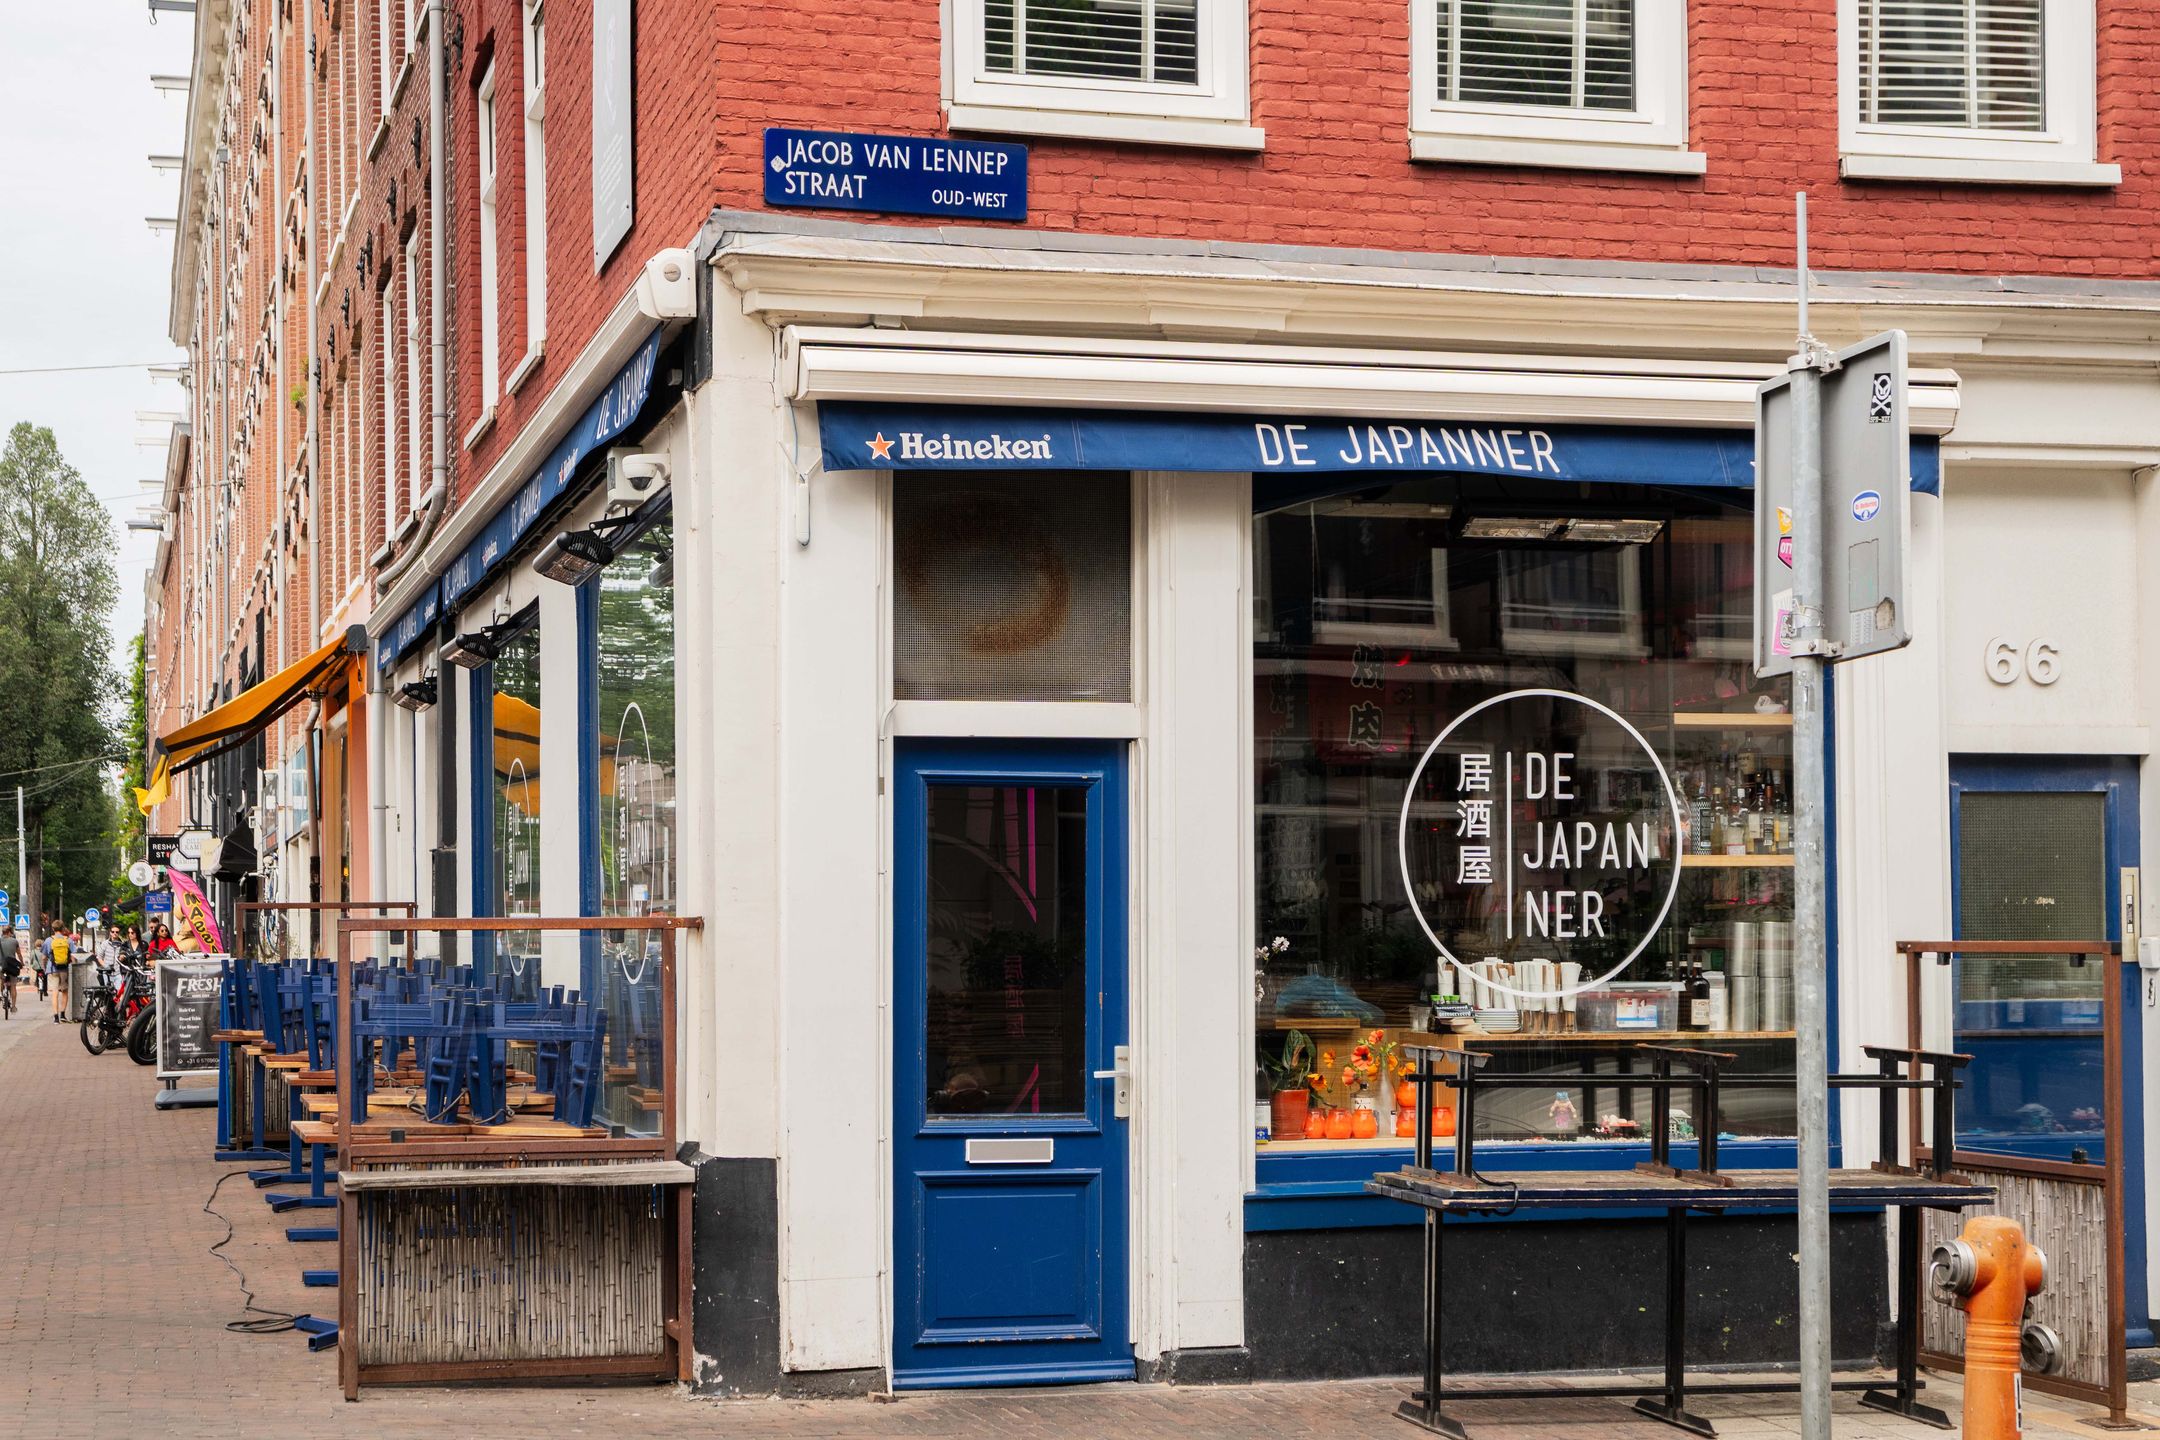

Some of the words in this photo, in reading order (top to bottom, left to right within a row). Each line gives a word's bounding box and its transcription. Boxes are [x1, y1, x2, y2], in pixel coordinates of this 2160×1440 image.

[785, 138, 853, 168] JACOB
[864, 143, 910, 170] VAN
[923, 147, 1008, 176] LENNEP
[785, 171, 867, 199] STRAAT
[932, 189, 1008, 208] OUD-WEST
[899, 432, 1053, 460] Heineken
[1255, 423, 1317, 466] DE
[1339, 424, 1561, 474] JAPANNER
[1983, 634, 2062, 686] 66
[1526, 752, 1575, 800] DE
[1456, 753, 1494, 885] 居酒屋
[152, 843, 179, 851] RESHA
[1523, 822, 1649, 869] JAPAN
[136, 867, 146, 882] 3
[1526, 890, 1605, 938] NER
[176, 976, 224, 999] FRESH
